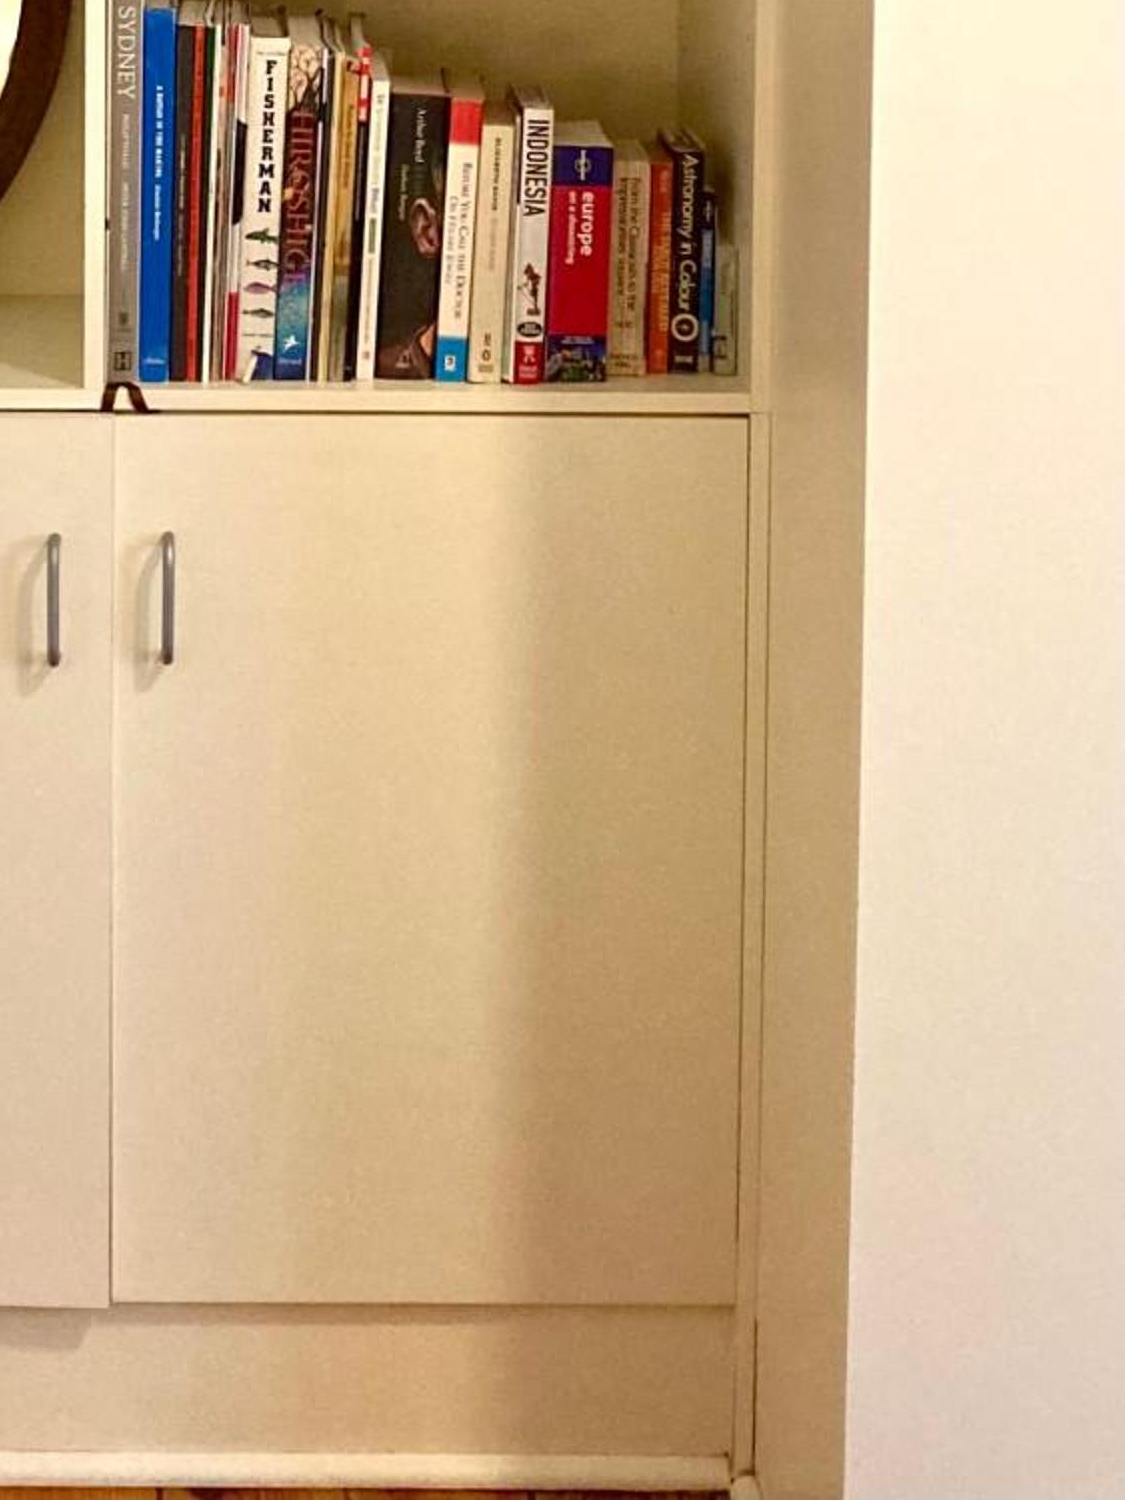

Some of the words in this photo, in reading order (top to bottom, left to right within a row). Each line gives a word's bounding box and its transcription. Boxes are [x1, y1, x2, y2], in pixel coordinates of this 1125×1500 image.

[116, 5, 139, 100] SYDNEY
[257, 59, 277, 213] FISHERMAN
[415, 107, 429, 140] Arthur
[413, 140, 427, 164] Boyd
[491, 137, 502, 185] ELIZABETH
[520, 119, 551, 217] INDONESIA
[282, 107, 317, 290] HIROSHIGE
[570, 190, 578, 204] on
[679, 153, 700, 238] Astronomy
[565, 214, 578, 265] shoestring
[578, 190, 597, 257] europe
[679, 241, 697, 256] in
[677, 259, 697, 312] Colour
